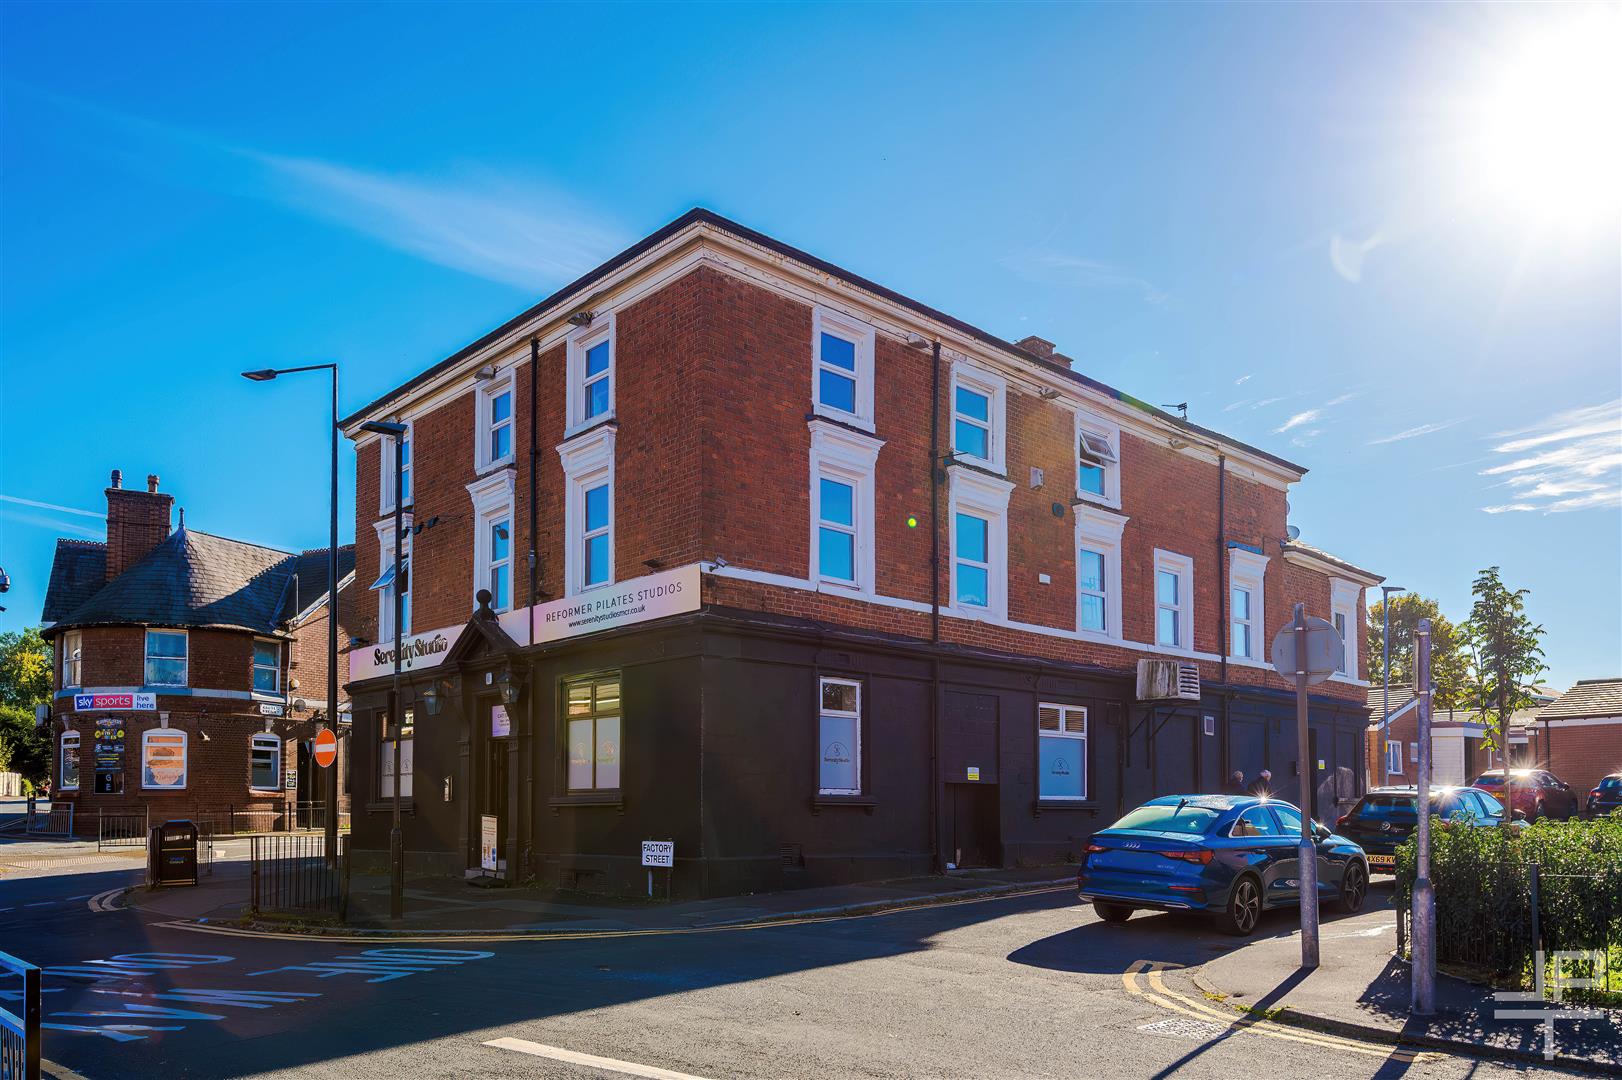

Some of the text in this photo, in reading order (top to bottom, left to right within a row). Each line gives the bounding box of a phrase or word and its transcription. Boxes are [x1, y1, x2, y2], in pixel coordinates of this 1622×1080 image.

[545, 581, 683, 623] REFORMER PILATES STUDIOS
[374, 634, 449, 668] Sereity Studio
[78, 697, 93, 708] sky
[95, 696, 131, 707] sports
[643, 843, 673, 853] FACTORY
[645, 854, 670, 864] STREET
